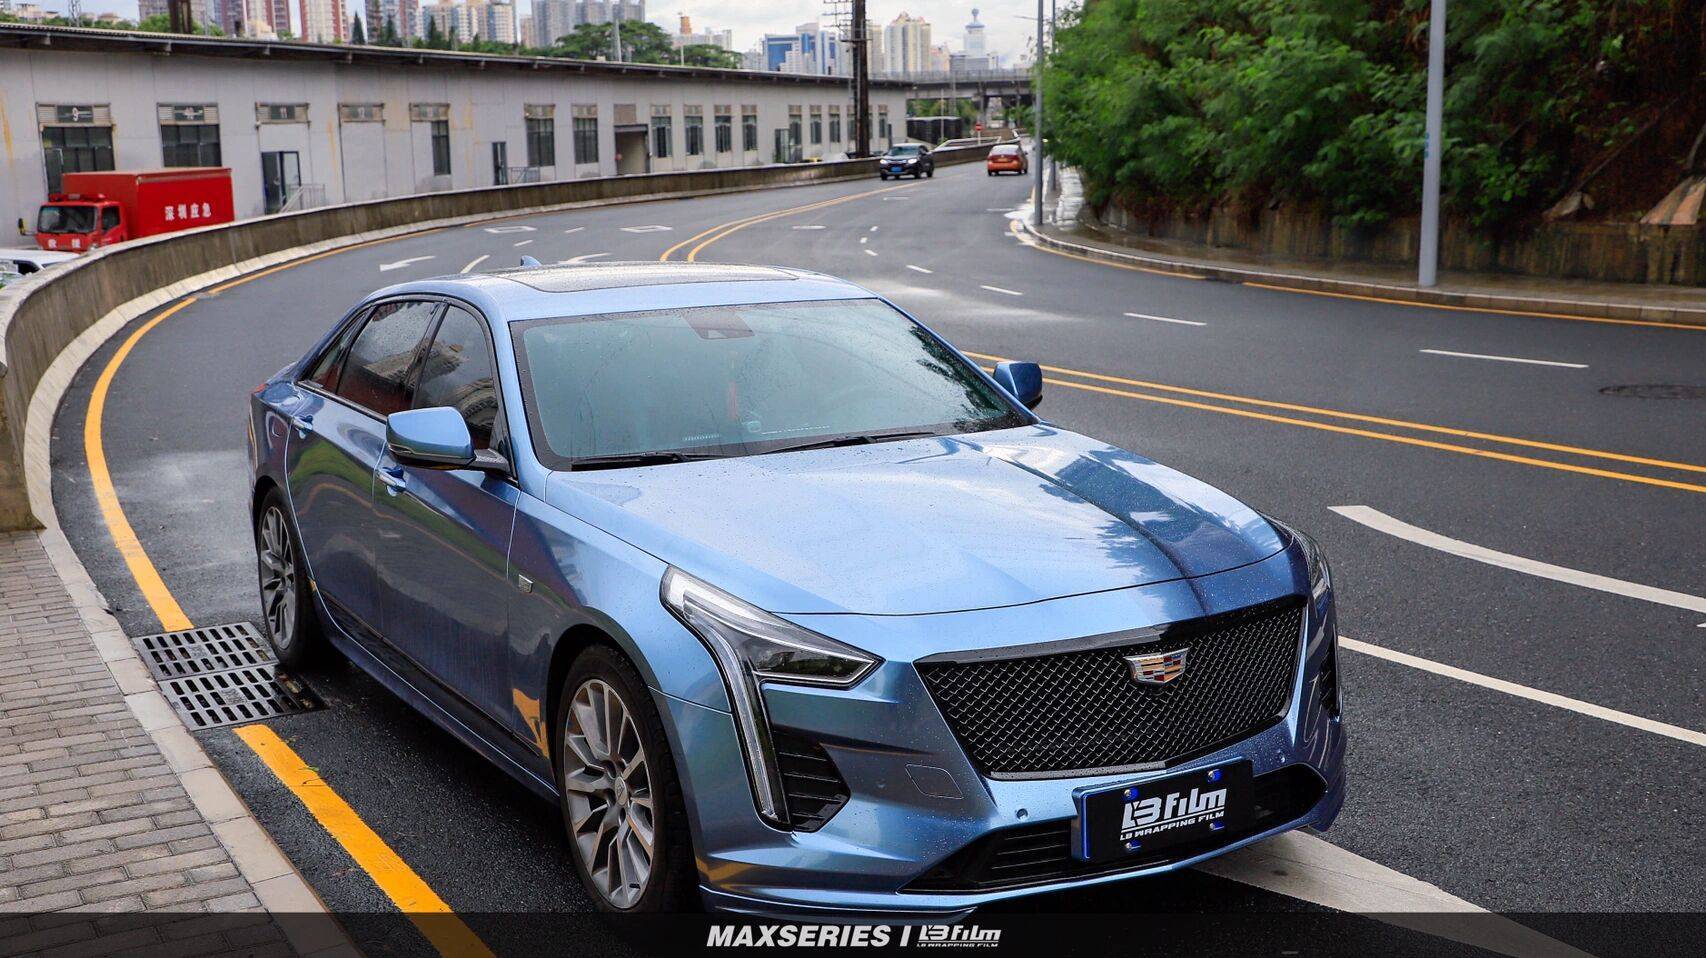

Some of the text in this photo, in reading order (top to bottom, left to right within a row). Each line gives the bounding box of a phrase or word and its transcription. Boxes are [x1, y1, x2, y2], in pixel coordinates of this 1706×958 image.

[165, 202, 211, 220] 深圳应急
[1120, 811, 1224, 841] LB WRAPPING FILM
